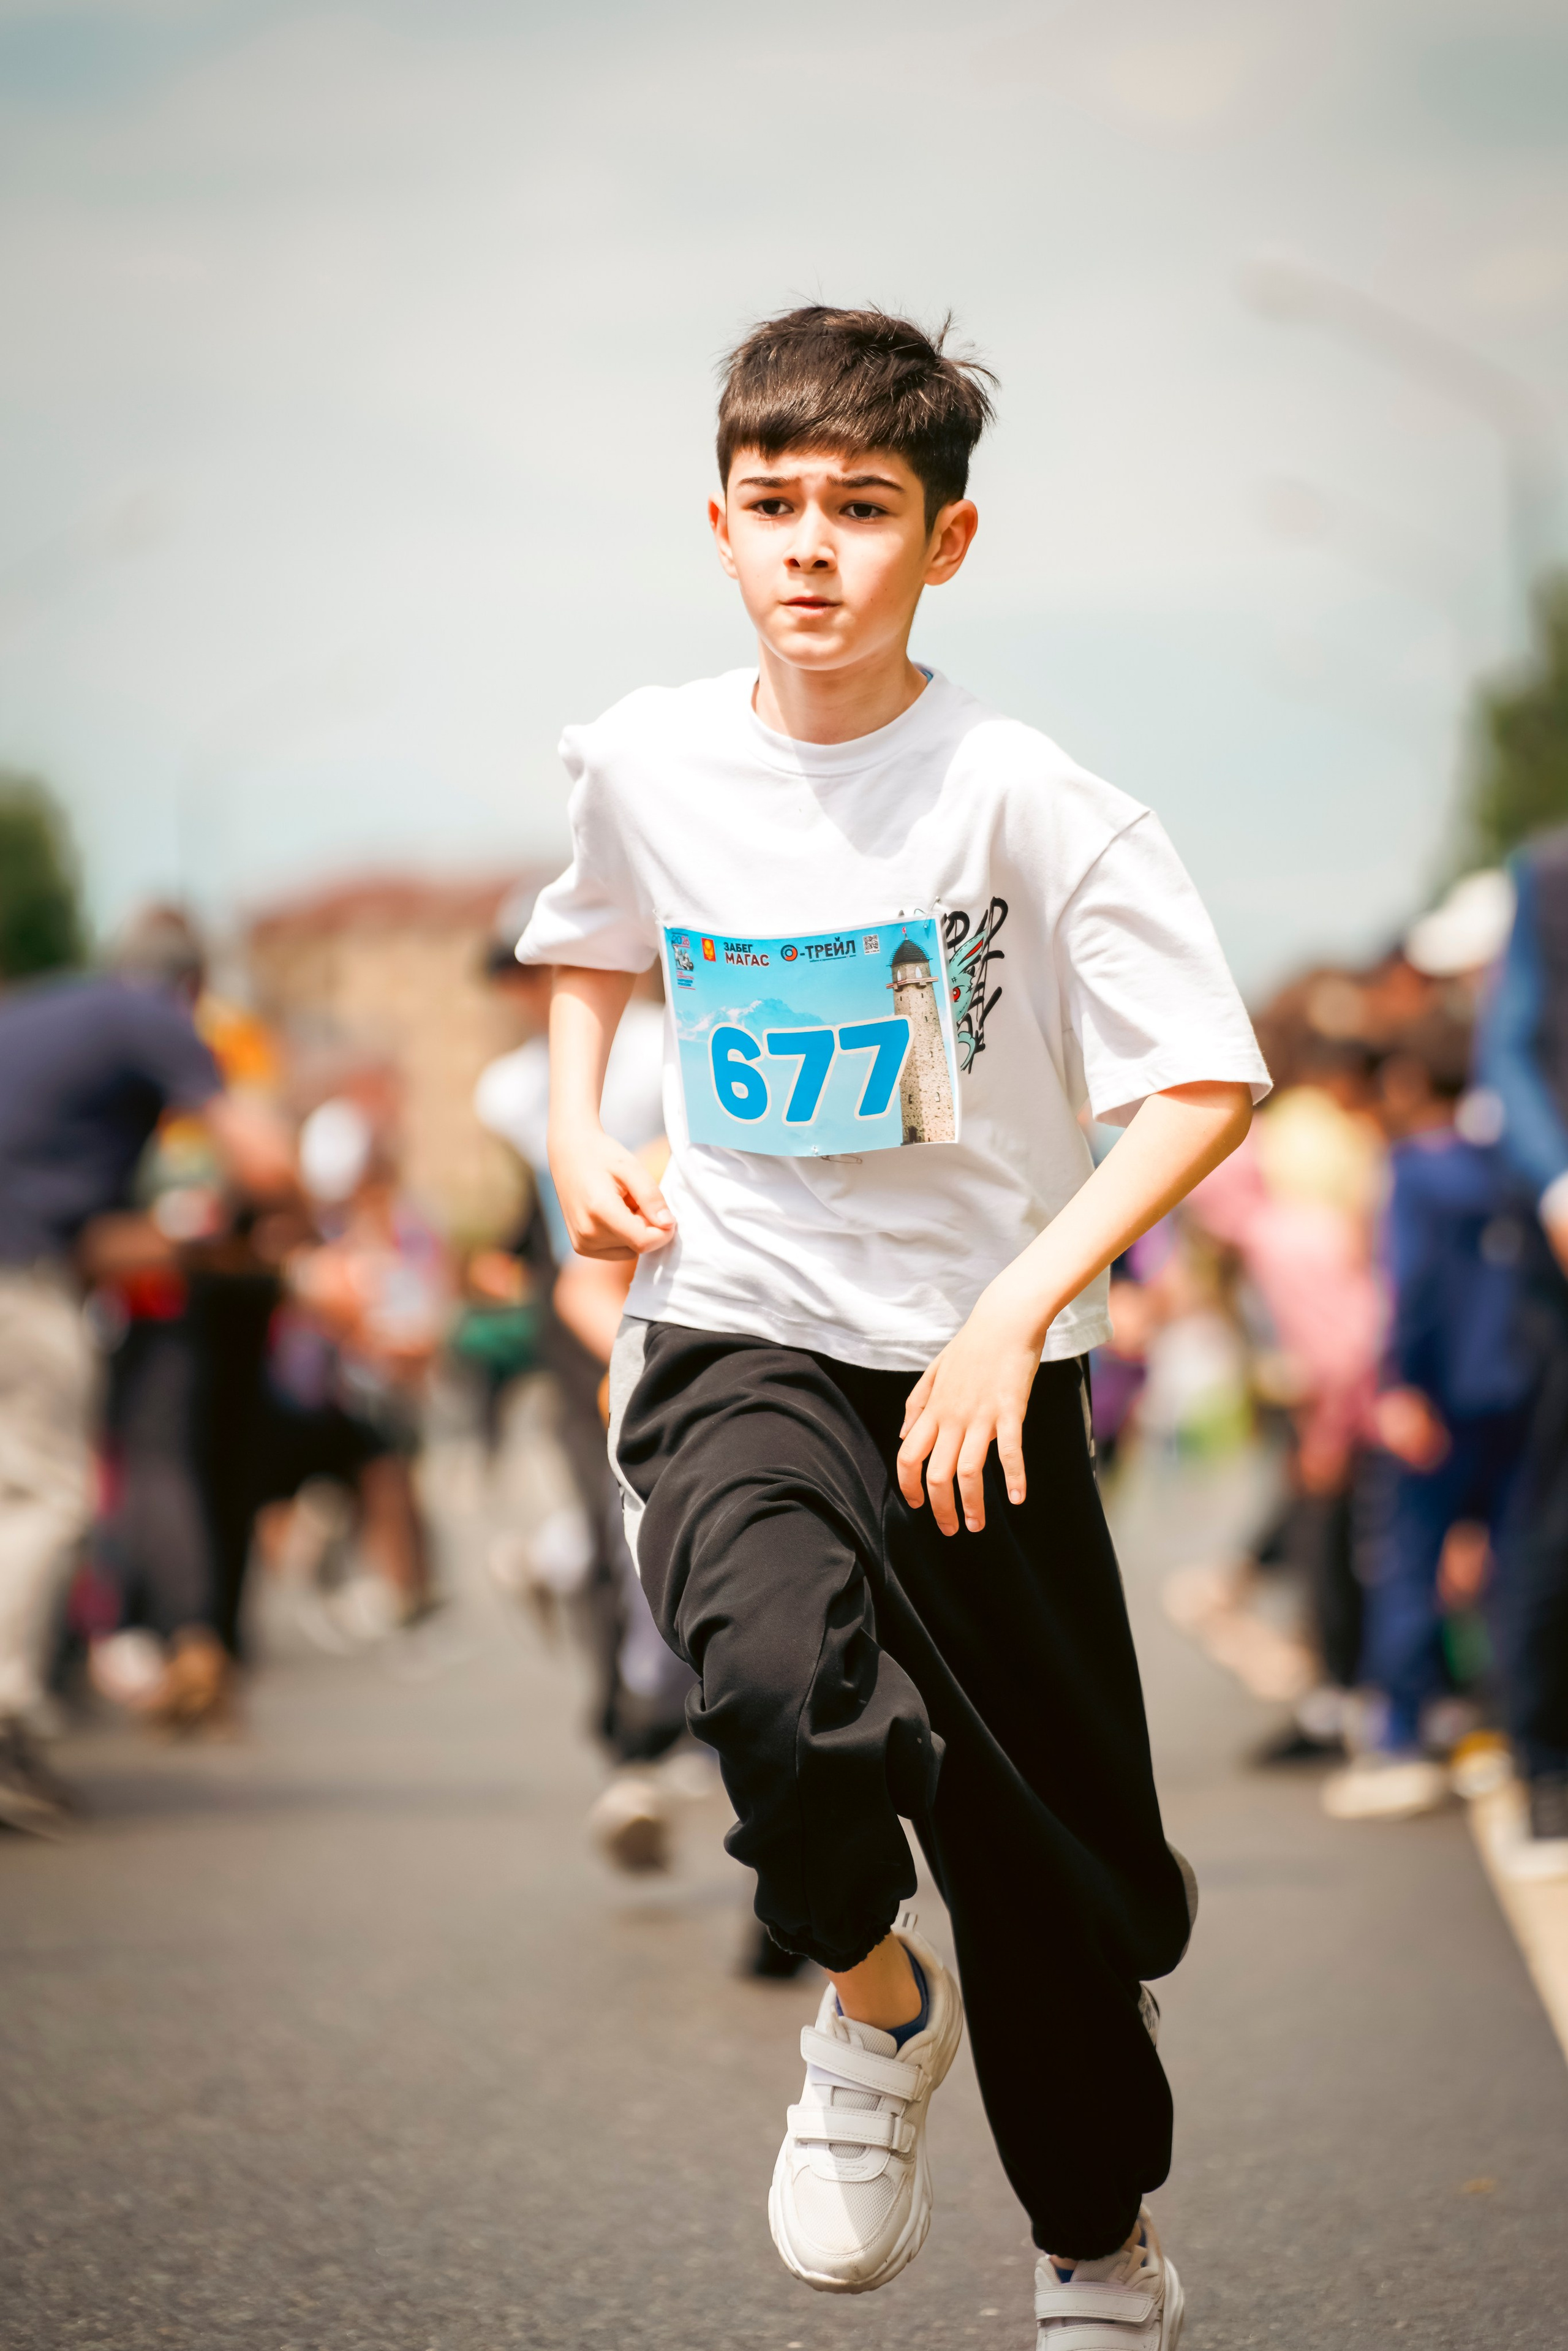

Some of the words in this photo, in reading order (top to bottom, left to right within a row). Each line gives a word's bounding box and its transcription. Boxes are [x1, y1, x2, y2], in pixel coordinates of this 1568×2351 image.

[723, 942, 753, 953] ЗАБЕГ
[725, 951, 770, 967] МАГАС
[710, 1017, 911, 1123] 677
